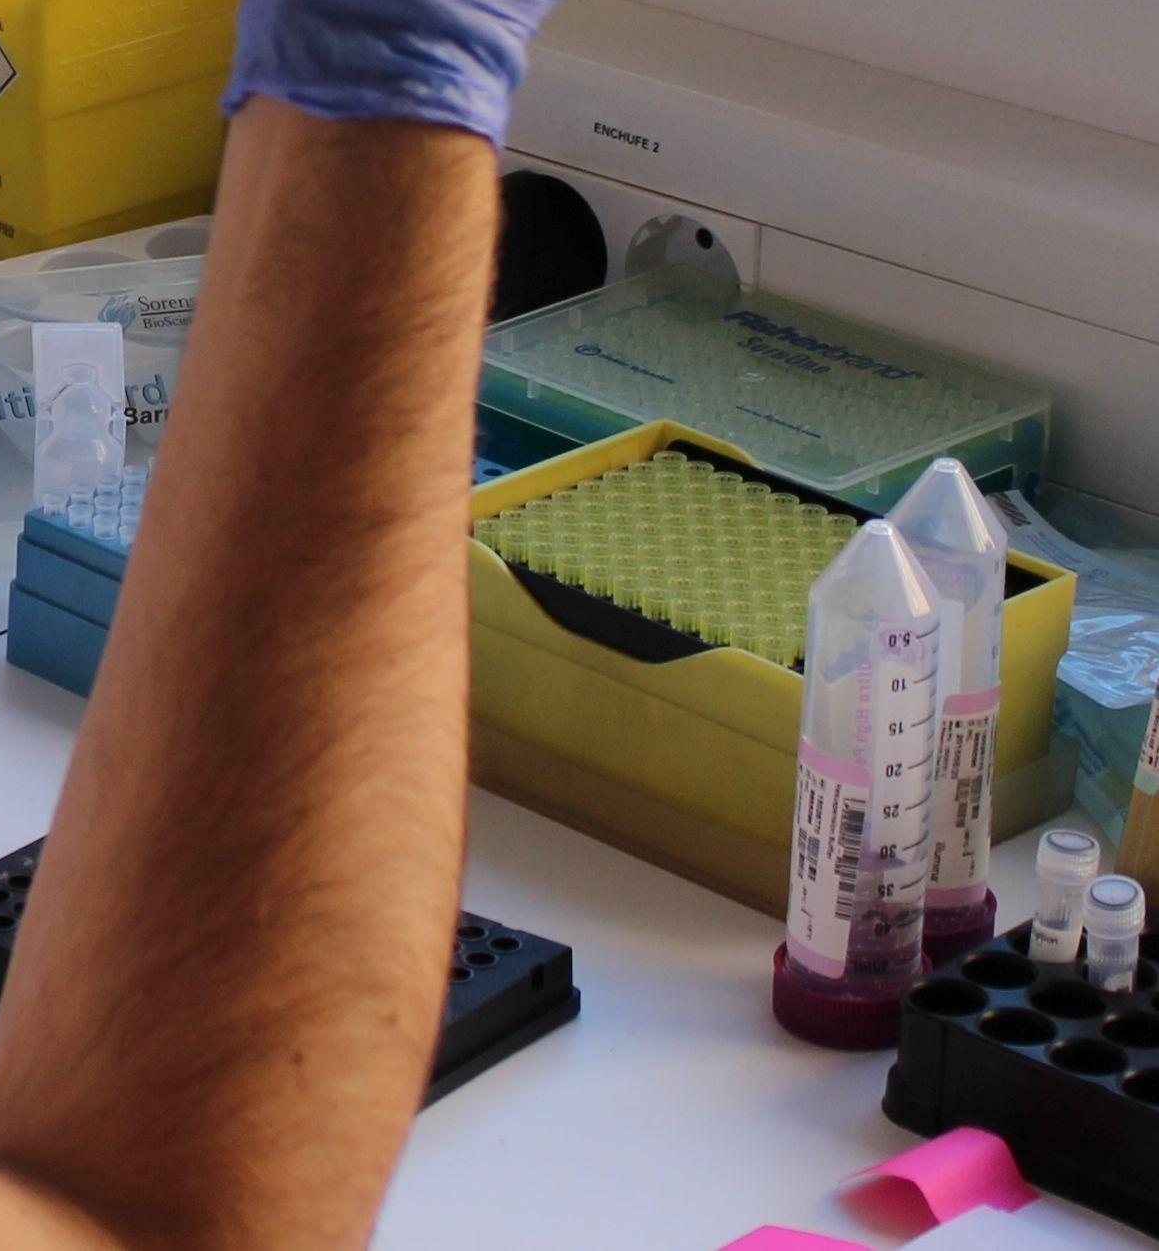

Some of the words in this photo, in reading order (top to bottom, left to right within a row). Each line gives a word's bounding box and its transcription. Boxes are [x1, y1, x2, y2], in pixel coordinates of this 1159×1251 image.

[593, 121, 650, 150] ENCHUFE
[652, 141, 661, 153] 2
[891, 678, 907, 693] 10
[888, 721, 904, 736] 15
[885, 763, 903, 778] 20
[883, 803, 899, 819] 25
[880, 844, 898, 859] 30
[878, 883, 895, 898] 35
